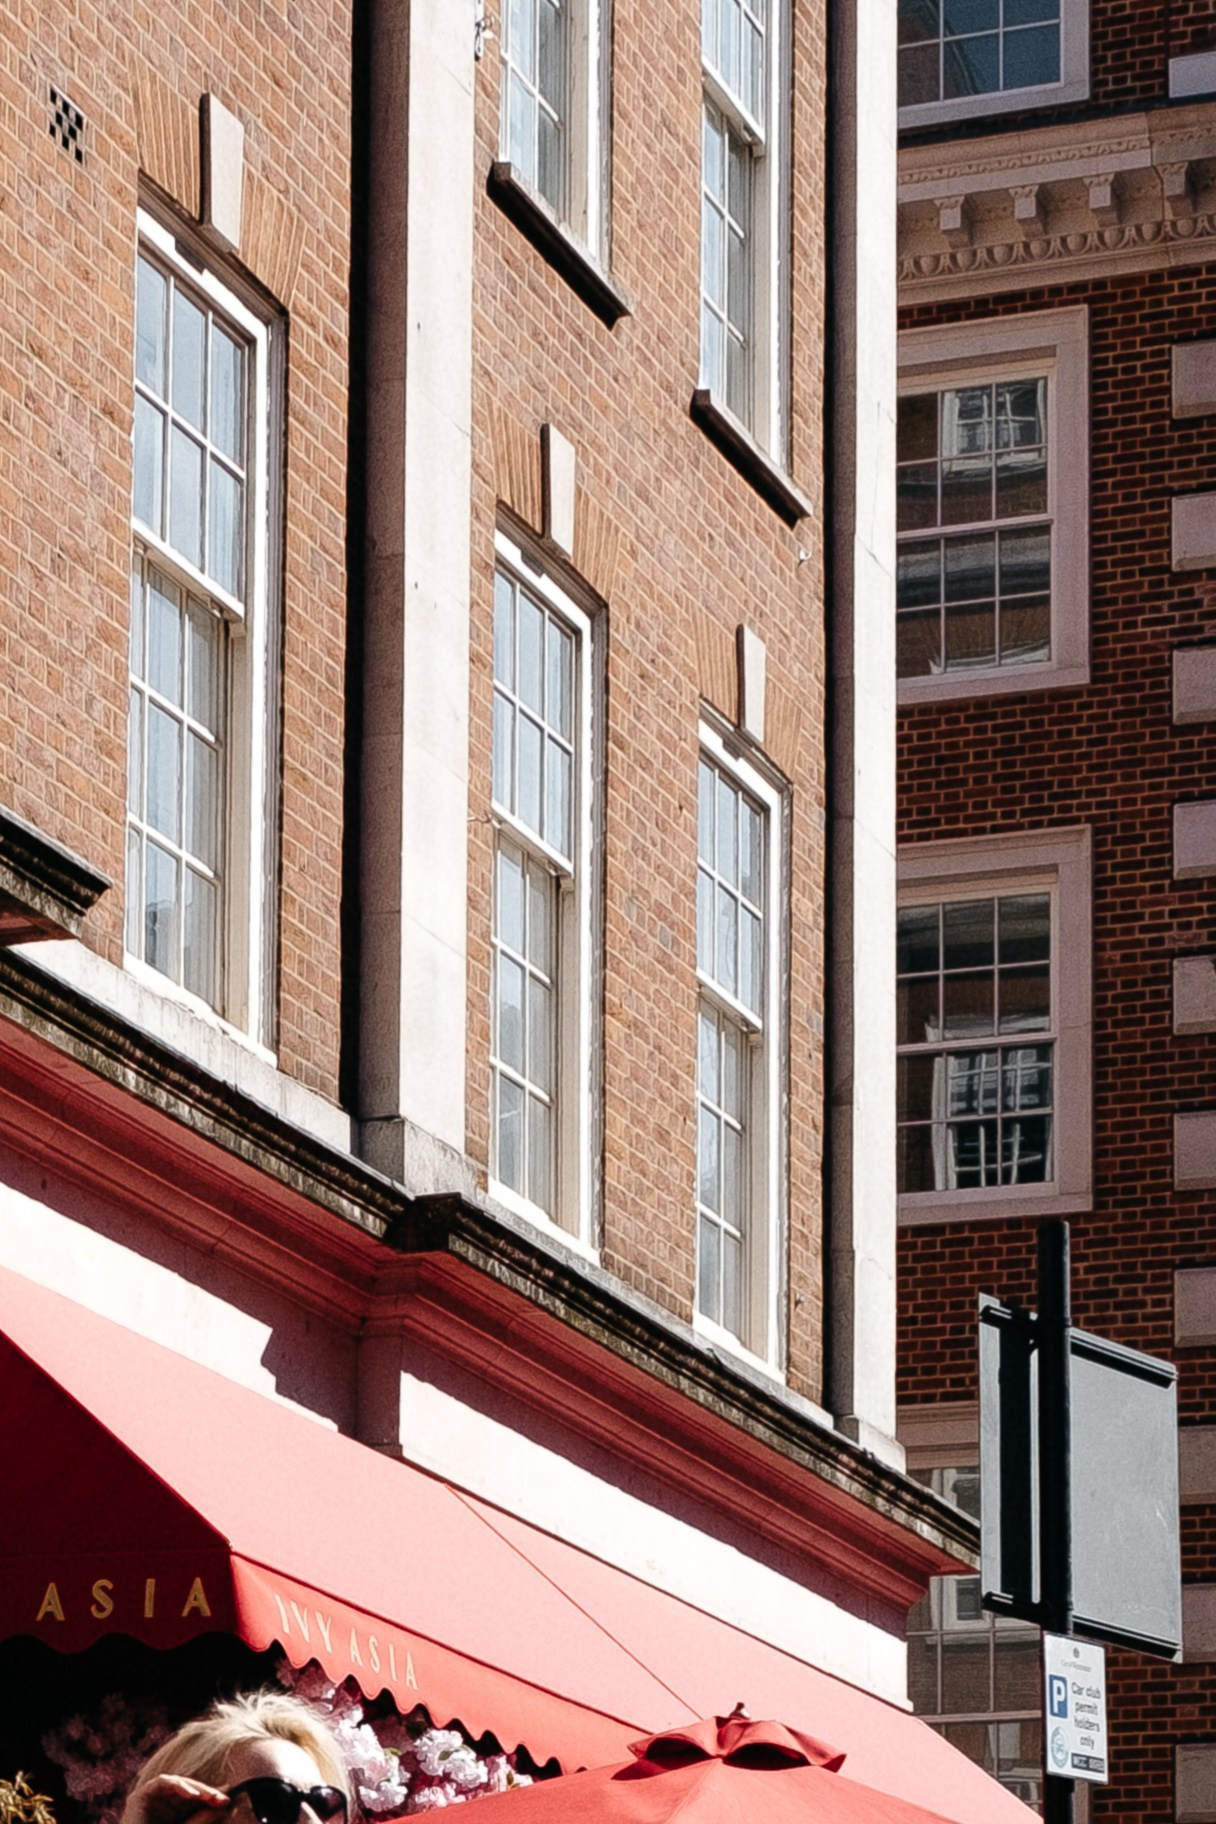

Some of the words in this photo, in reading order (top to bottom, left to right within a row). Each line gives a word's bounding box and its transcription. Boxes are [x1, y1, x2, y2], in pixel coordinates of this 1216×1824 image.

[35, 1576, 213, 1621] ASIA
[274, 1592, 333, 1654] IVY
[349, 1626, 419, 1691] ASIA
[1052, 1679, 1066, 1714] P
[1071, 1681, 1084, 1696] Car
[1085, 1684, 1102, 1700] club
[1074, 1702, 1099, 1716] permit
[1073, 1715, 1100, 1733] holders
[1079, 1735, 1095, 1750] only
